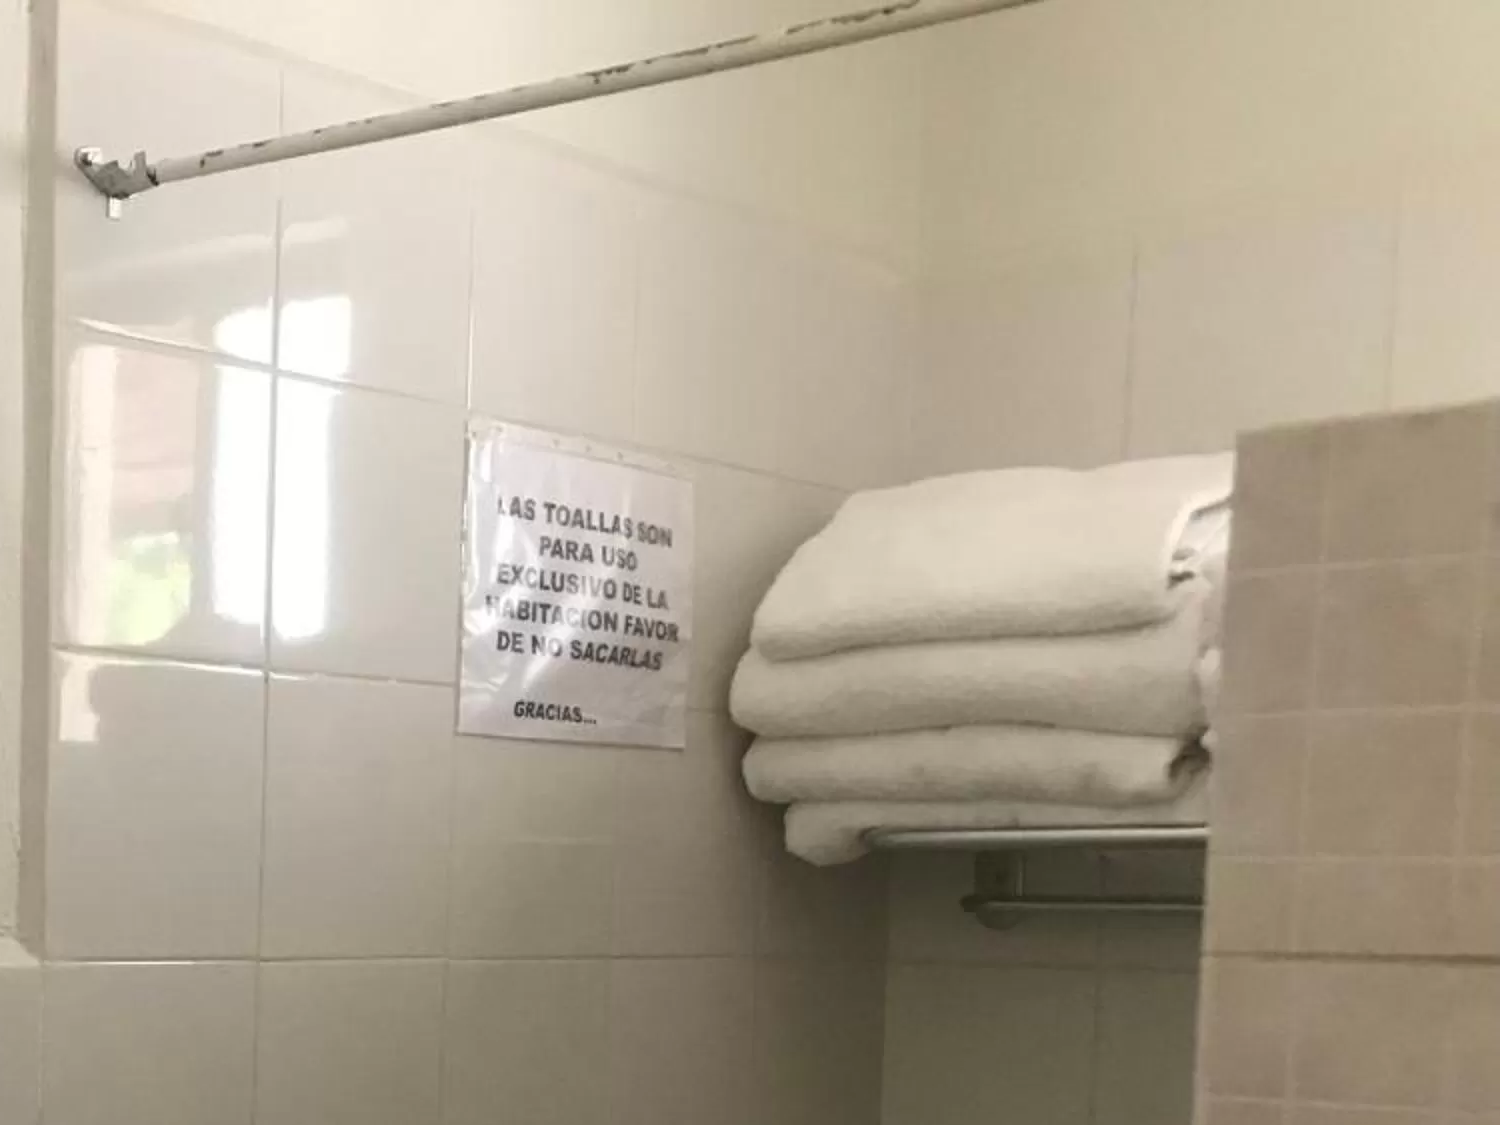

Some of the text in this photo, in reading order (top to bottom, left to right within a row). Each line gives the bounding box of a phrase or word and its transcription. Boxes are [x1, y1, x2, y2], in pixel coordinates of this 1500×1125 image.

[543, 501, 633, 539] TOALLAS
[637, 521, 673, 548] SON
[539, 536, 638, 571] PARA USO
[497, 564, 669, 610] EXCLUSIVO DE LA
[624, 615, 679, 643] FAVOR
[496, 630, 663, 671] DE NO SACARLAS
